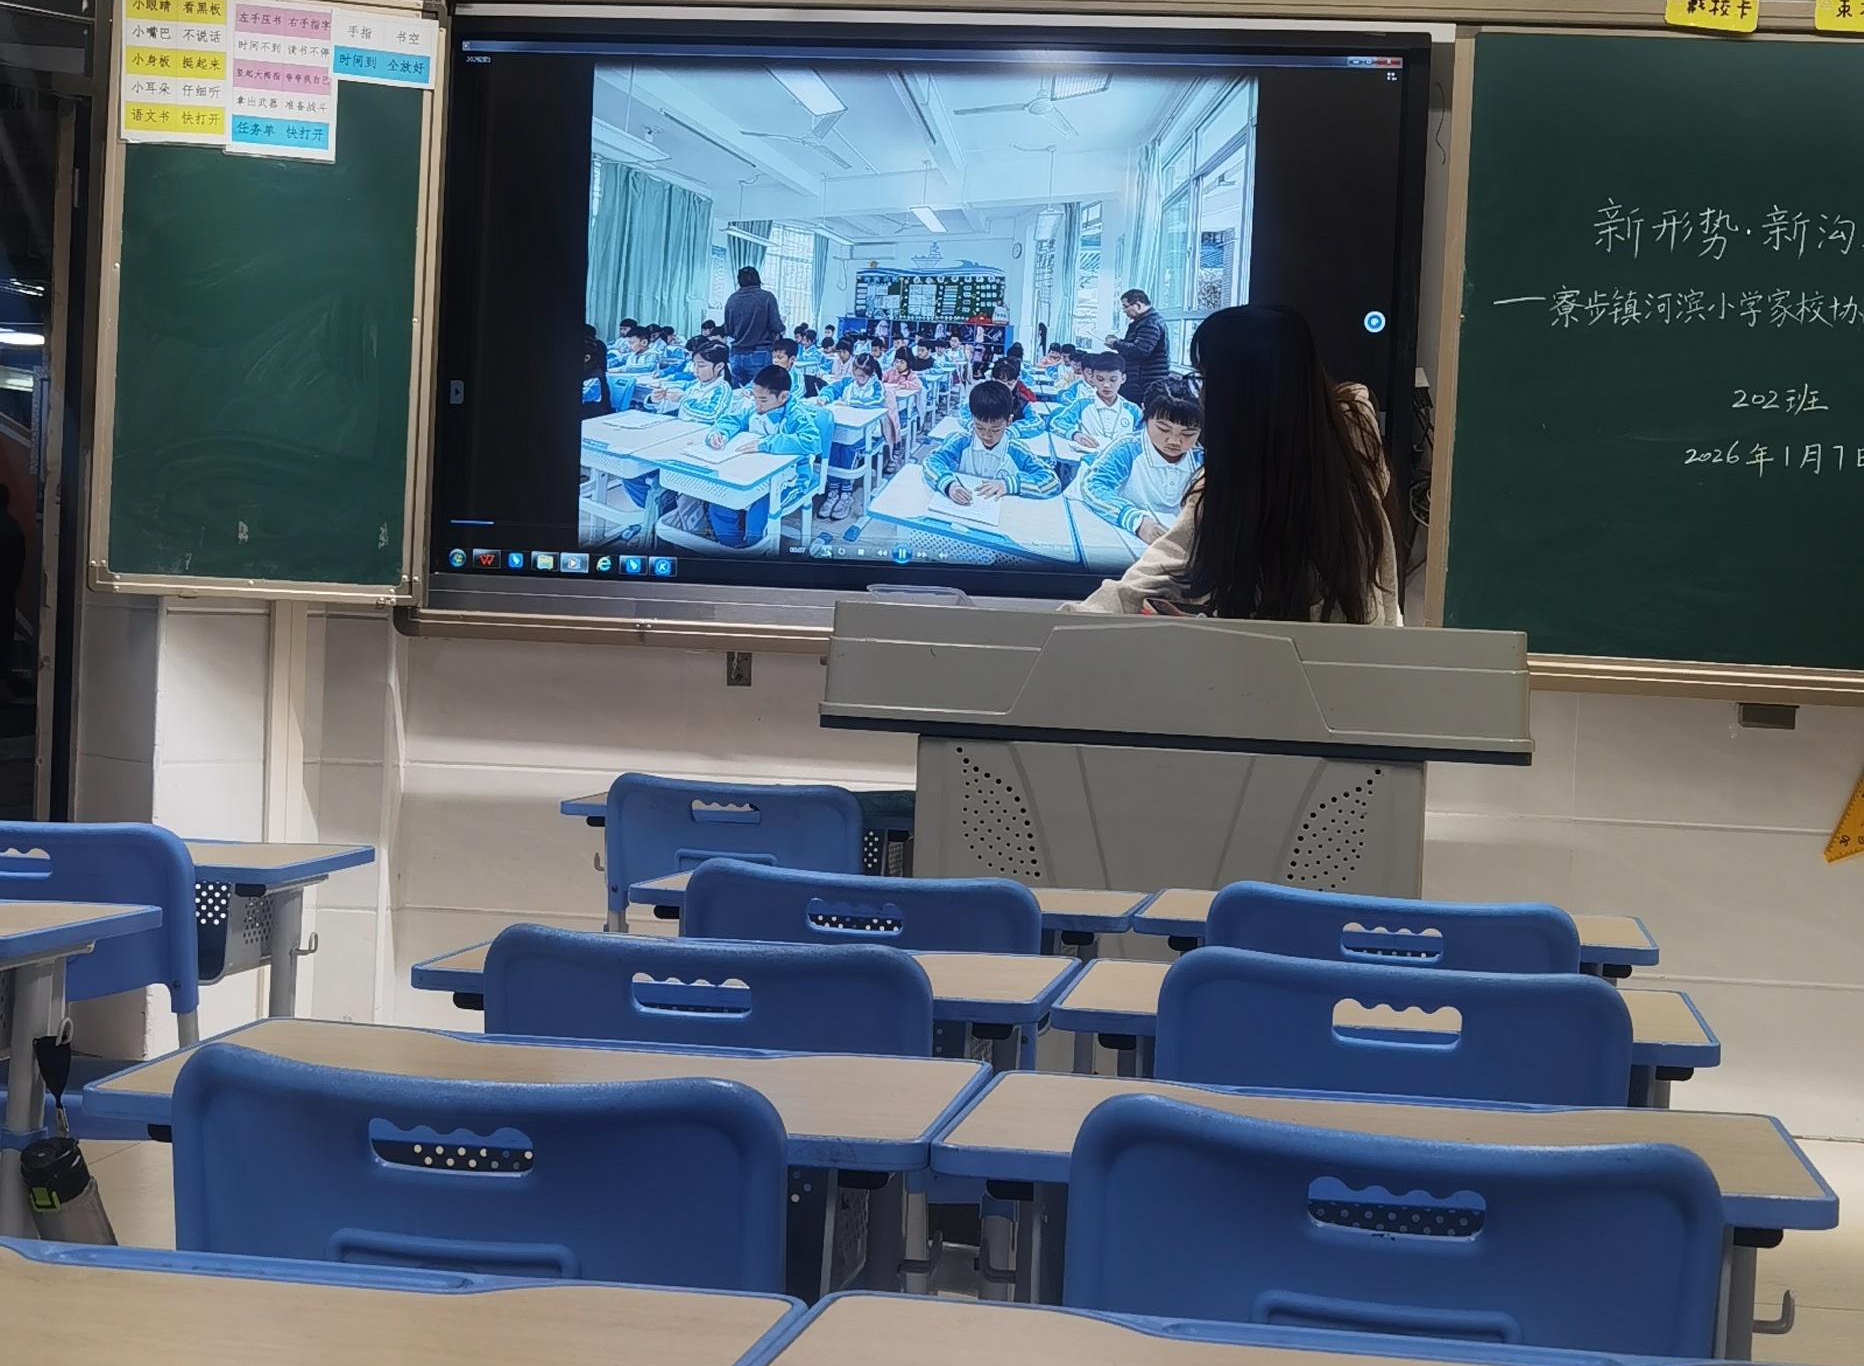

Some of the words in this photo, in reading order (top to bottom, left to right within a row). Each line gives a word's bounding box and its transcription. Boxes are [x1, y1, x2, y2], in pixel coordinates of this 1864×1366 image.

[183, 1, 222, 16] 看黑板
[132, 25, 171, 40] 小嘴巴
[183, 29, 221, 43] 不说话
[347, 25, 373, 39] 手指
[396, 30, 420, 45] 书空
[132, 53, 171, 68] 小身板
[182, 56, 221, 71] 挺起来
[339, 53, 377, 70] 时间到
[387, 58, 425, 75] 全放好
[131, 80, 171, 95] 小耳朵
[182, 84, 221, 99] 仔细听
[131, 108, 170, 123] 语文书
[182, 111, 220, 126] 快打开
[236, 121, 276, 137] 任务单
[286, 125, 325, 141] 快打开
[1594, 197, 1864, 261] 新形势·新沟
[1731, 383, 1829, 415] 202班
